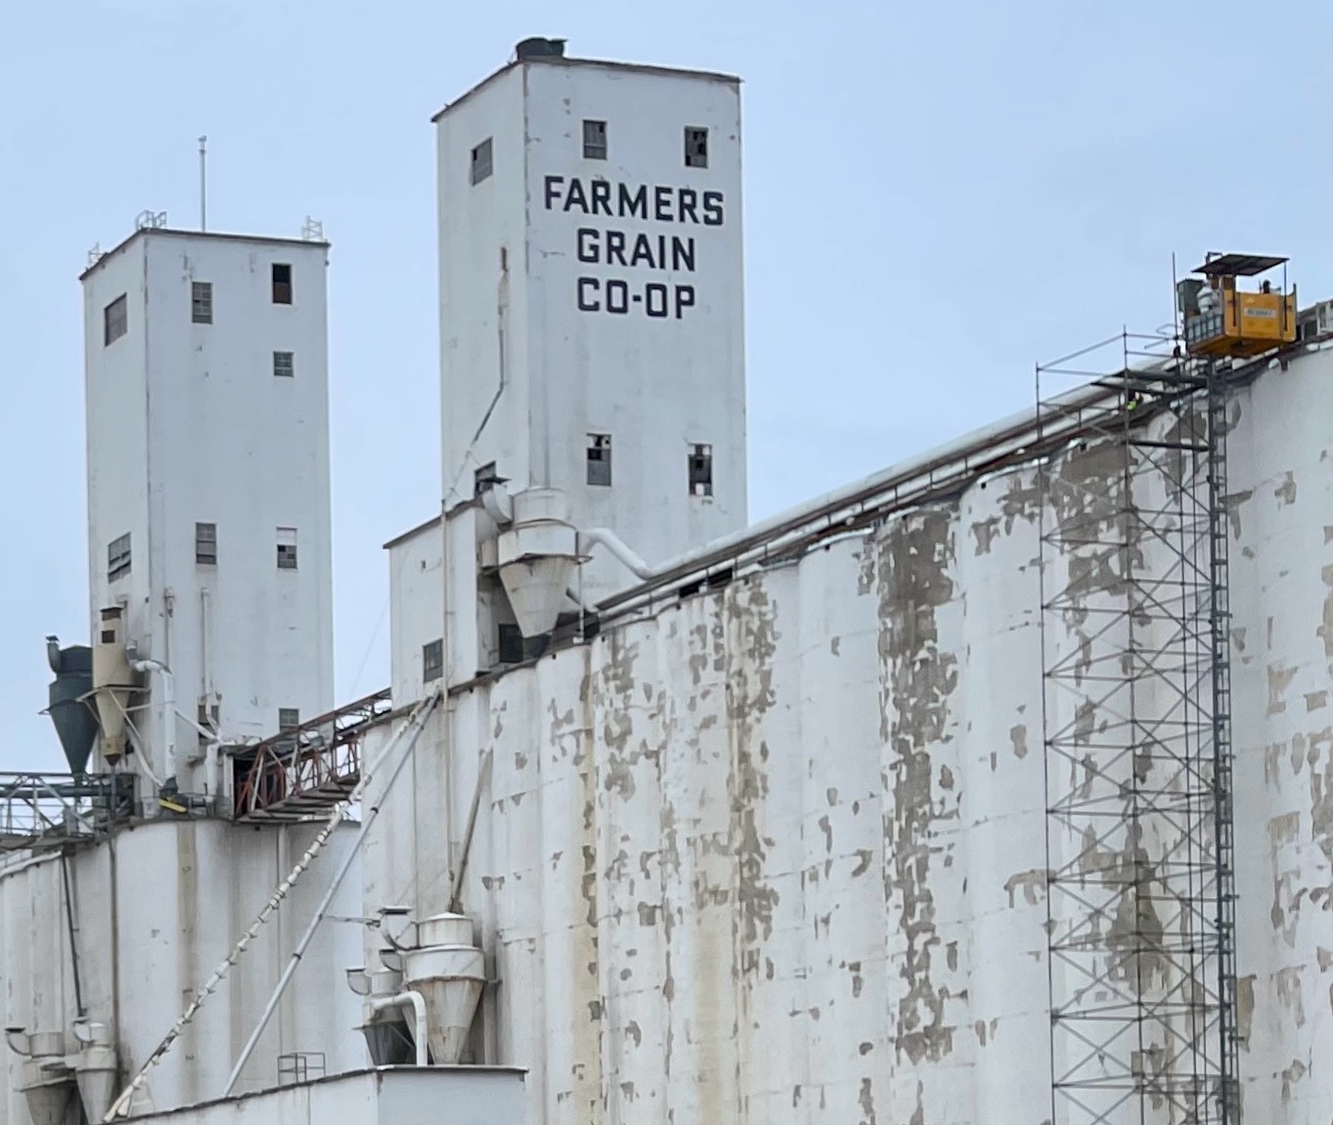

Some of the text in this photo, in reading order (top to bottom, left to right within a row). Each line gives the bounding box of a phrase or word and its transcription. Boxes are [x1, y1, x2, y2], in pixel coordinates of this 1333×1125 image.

[544, 175, 724, 226] FARMERS
[577, 228, 696, 272] GRAIN
[577, 277, 696, 320] CO-OP
